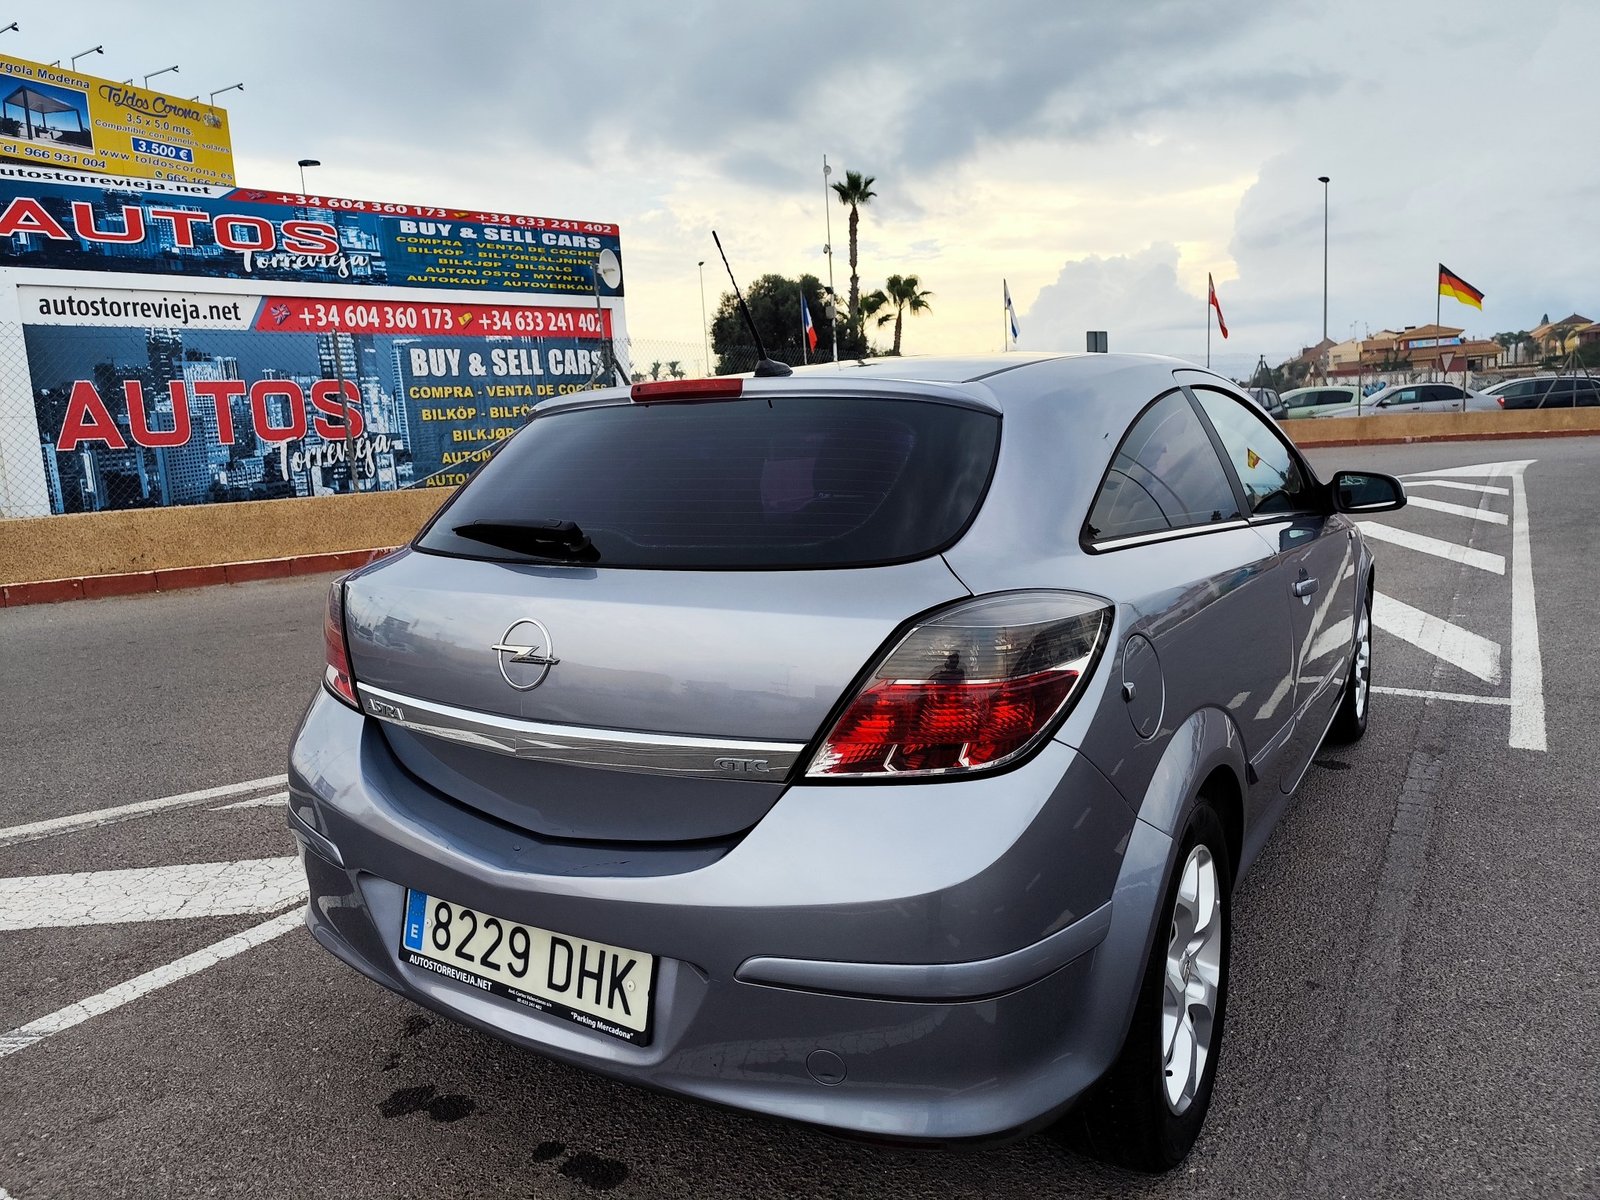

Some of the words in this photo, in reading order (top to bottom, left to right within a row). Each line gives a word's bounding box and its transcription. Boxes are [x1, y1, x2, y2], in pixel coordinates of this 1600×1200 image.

[0, 60, 33, 76] rgola
[37, 68, 90, 89] Moderna
[98, 84, 149, 110] Toldos
[152, 96, 201, 122] Corona
[95, 118, 146, 136] Compatible
[148, 131, 165, 139] con
[167, 135, 199, 147] paneles
[201, 143, 230, 154] solares
[126, 112, 142, 125] 3,5
[154, 120, 170, 131] 5,0
[172, 124, 194, 136] mts.
[24, 147, 50, 159] 966
[54, 152, 78, 164] 931
[82, 157, 107, 169] 004
[138, 140, 176, 159] 3.500
[179, 149, 189, 160] €
[0, 168, 212, 195] utostorrevieja.net
[0, 196, 340, 256] AUTOS
[276, 194, 322, 207] +34
[327, 198, 366, 210] 604
[371, 202, 408, 214] 360
[413, 206, 447, 218] 173
[475, 213, 512, 224] +34
[515, 216, 546, 228] 633
[550, 219, 580, 231] 241
[584, 223, 612, 234] 402
[396, 236, 463, 248] COMPRA
[476, 242, 524, 252] VENTA
[528, 246, 546, 254] DE
[399, 220, 452, 237] BUY
[459, 227, 478, 239] &
[483, 227, 536, 245] SELL
[541, 233, 601, 250] CARS
[235, 249, 370, 278] Torrevieja
[407, 246, 464, 256] BILKÖP
[425, 266, 477, 276] AUTON
[481, 270, 521, 279] OSTO
[533, 273, 585, 282] MYYNTI
[515, 263, 573, 273] BILSALG
[406, 275, 489, 286] AUTOKAUF
[502, 279, 597, 291] AUTOVERKAU
[39, 296, 242, 326] autostorrevieja.net
[299, 304, 340, 327] +34
[344, 305, 380, 328] 604
[384, 306, 418, 329] 360
[421, 308, 453, 330] 173
[478, 310, 512, 331] +34
[515, 311, 544, 331] 633
[547, 312, 574, 331] 241
[578, 313, 602, 332] 402
[409, 348, 461, 377] BUY
[468, 352, 487, 376] &
[491, 349, 544, 376] SELL
[548, 348, 605, 376] CARS
[409, 384, 474, 399] COMPRA
[486, 384, 533, 397] VENTA
[537, 384, 554, 396] DE
[56, 379, 365, 452] AUTOS
[421, 406, 476, 421] BILKÖP
[489, 404, 532, 419] BILFÖ
[273, 432, 391, 481] Torreveja
[426, 473, 469, 487] AUTO
[714, 757, 769, 772] GTC
[411, 924, 418, 938] E
[432, 901, 530, 978] 8229
[547, 936, 636, 1016] DHK
[409, 954, 492, 991] AUTOSTORREVIEJA.NET
